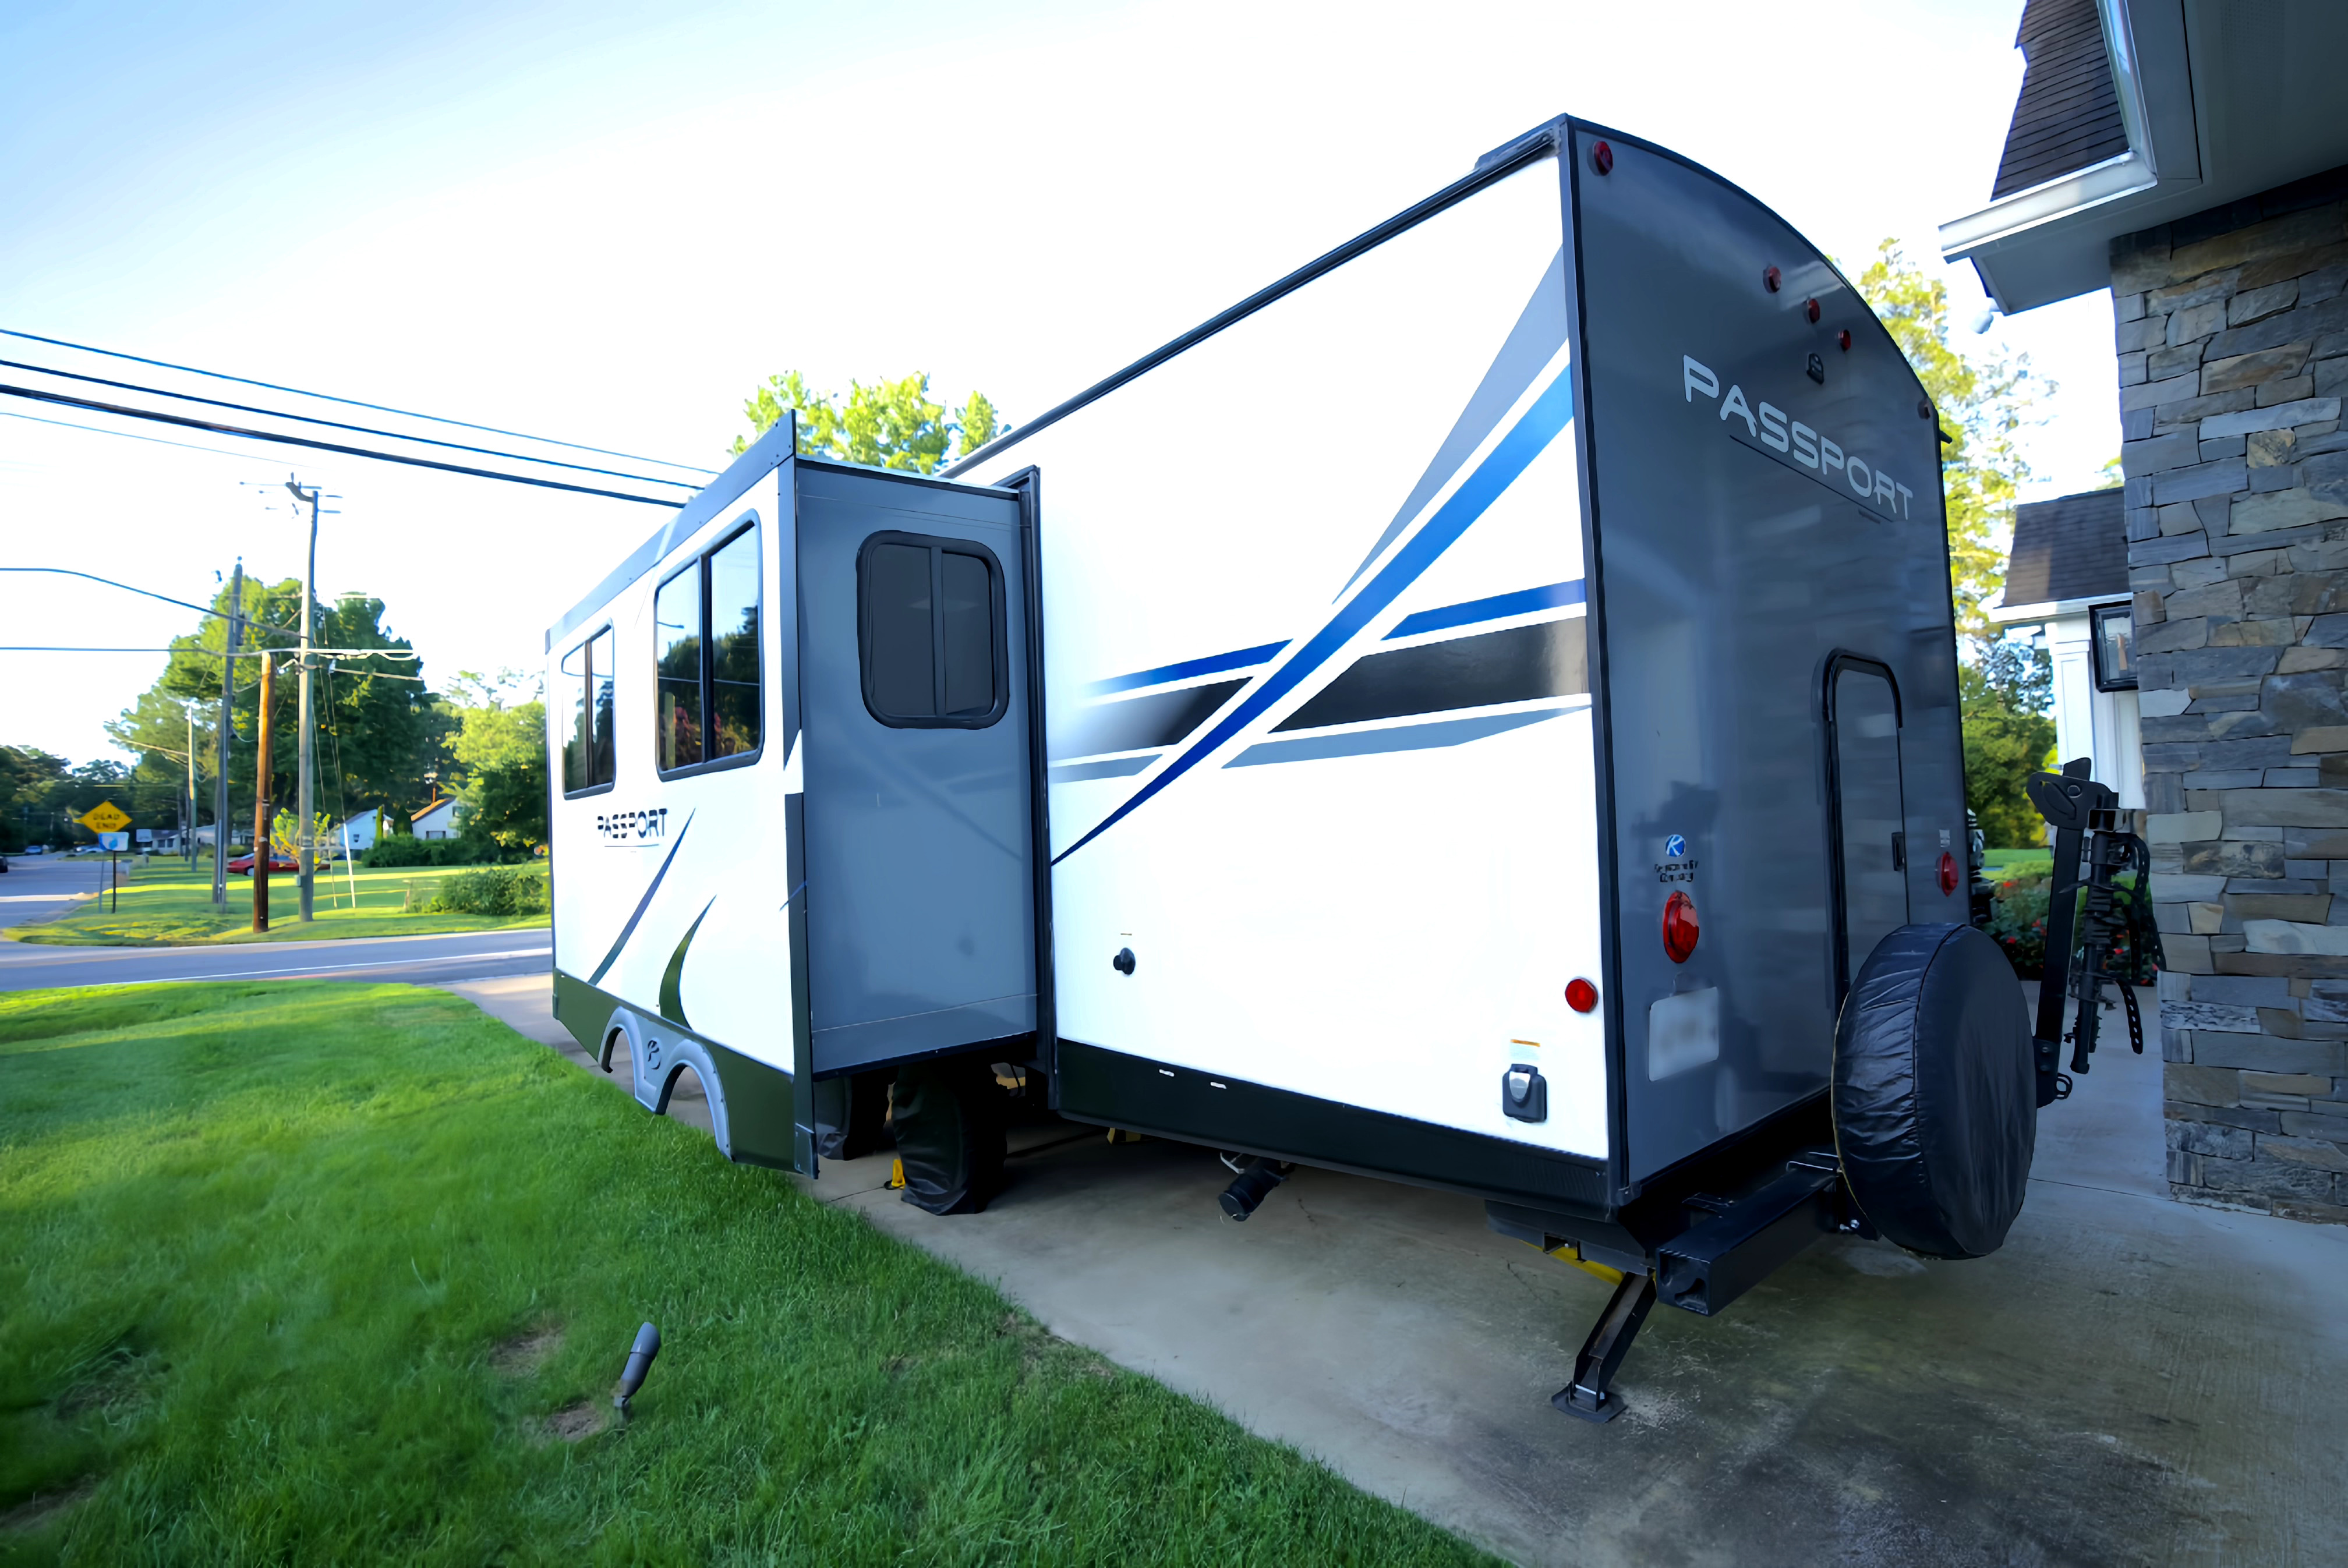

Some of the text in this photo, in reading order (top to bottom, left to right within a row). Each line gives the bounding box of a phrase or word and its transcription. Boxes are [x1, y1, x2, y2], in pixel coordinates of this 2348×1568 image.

[1684, 355, 1913, 520] PASSPORT
[96, 822, 116, 830] END
[597, 808, 667, 838] PASSPORT
